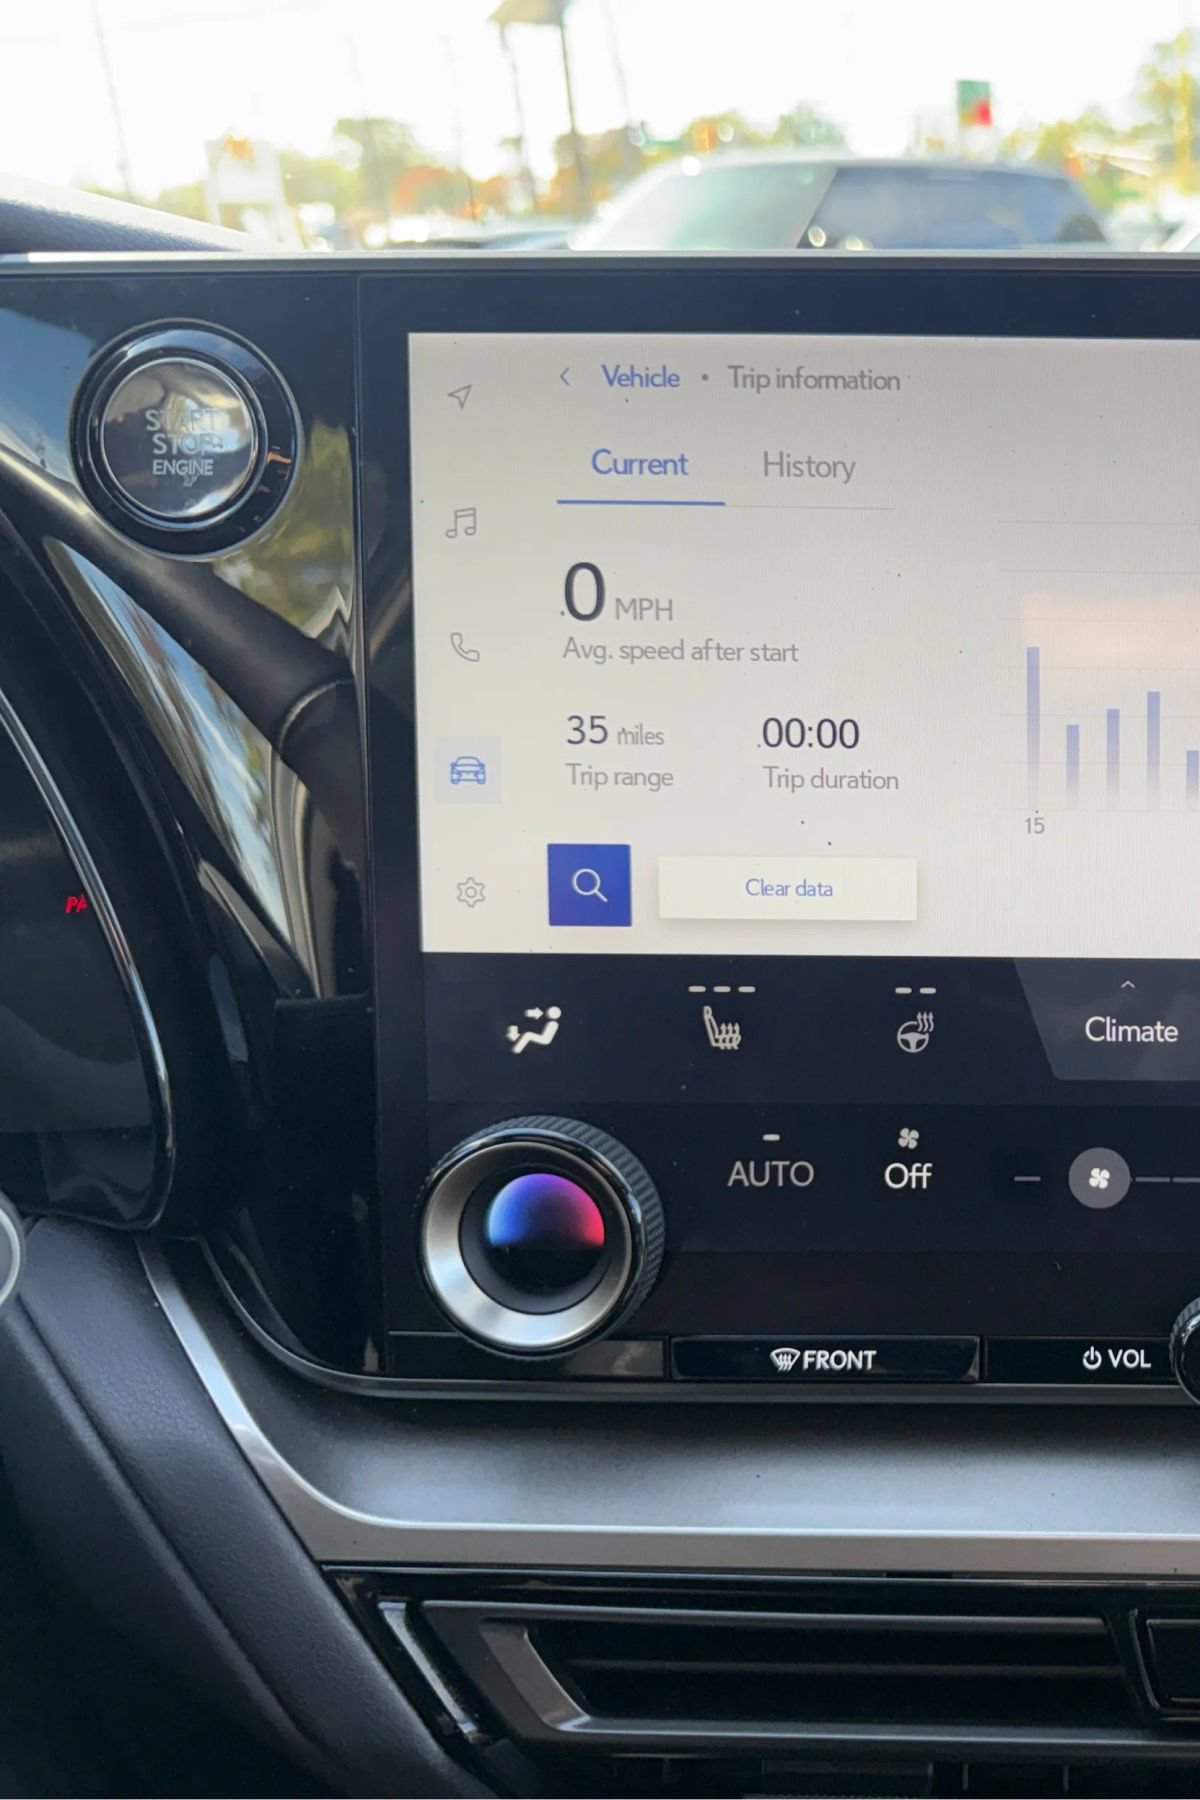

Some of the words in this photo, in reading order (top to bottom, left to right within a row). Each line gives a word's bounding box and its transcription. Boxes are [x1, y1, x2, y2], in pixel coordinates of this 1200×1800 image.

[600, 363, 681, 388] Vehicle
[727, 365, 770, 394] Trip
[775, 365, 901, 391] information
[145, 408, 221, 431] START
[152, 433, 219, 455] STOP
[152, 459, 214, 476] ENGINE
[591, 447, 689, 476] Current
[763, 450, 857, 485] History
[565, 561, 606, 622] 0
[614, 597, 674, 622] MPH
[562, 636, 613, 665] Avg.
[619, 637, 685, 665] speed
[690, 637, 745, 662] after
[749, 643, 800, 663] start
[566, 714, 609, 745] 35
[616, 722, 665, 746] miles
[762, 717, 860, 750] 00:00
[565, 763, 609, 792] Trip
[613, 771, 675, 793] range
[762, 766, 805, 794] Trip
[810, 767, 900, 790] duration
[1024, 816, 1046, 835] 15
[745, 877, 791, 897] Clear
[794, 877, 834, 897] data
[1085, 1015, 1179, 1043] Climate
[727, 1160, 815, 1187] AUTO
[884, 1162, 933, 1189] Off
[803, 1349, 877, 1370] FRONT
[1107, 1348, 1152, 1369] VOL
